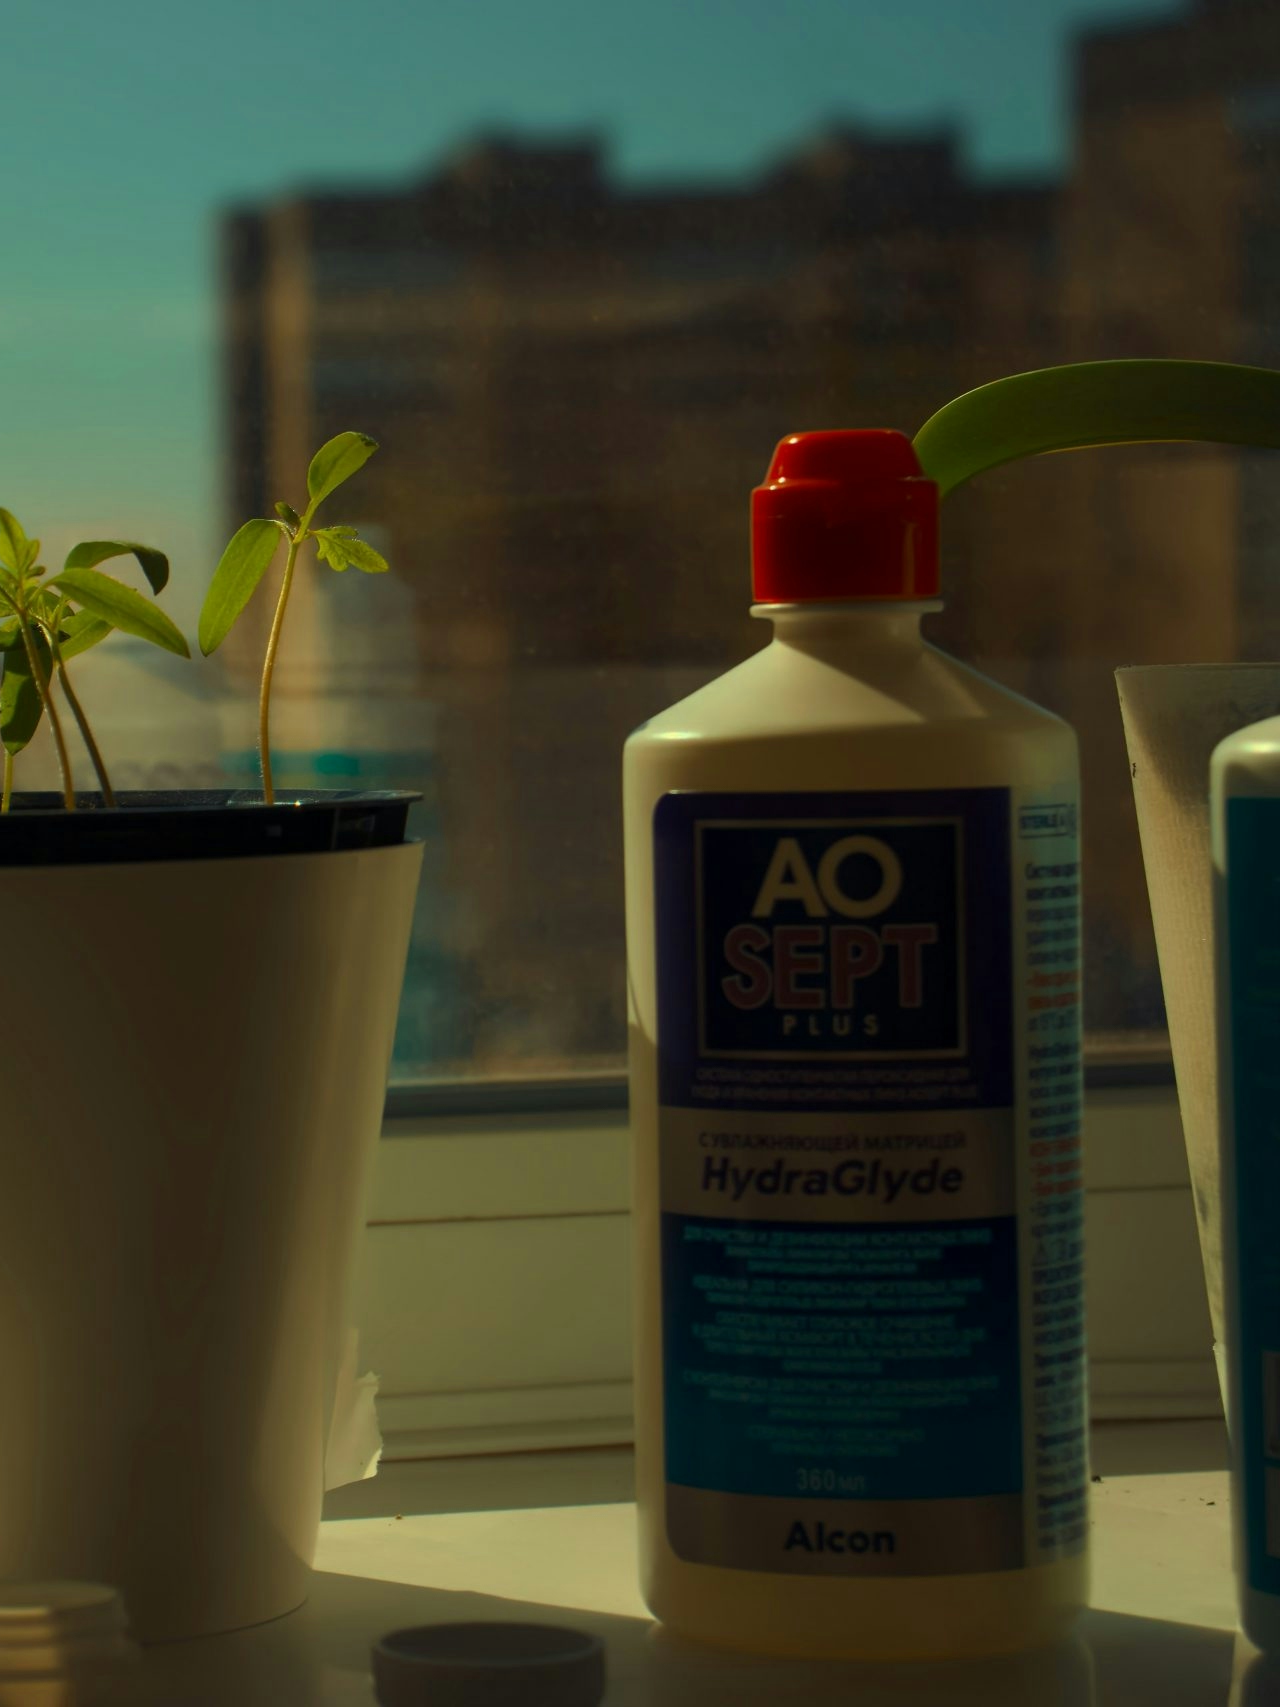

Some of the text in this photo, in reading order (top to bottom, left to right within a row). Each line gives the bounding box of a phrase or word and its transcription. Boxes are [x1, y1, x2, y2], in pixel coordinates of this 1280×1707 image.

[751, 834, 906, 919] AO
[721, 923, 939, 1011] SEPT
[782, 1013, 882, 1038] PLUS
[701, 1155, 965, 1203] HydraGlyde
[784, 1521, 898, 1552] Alcon
